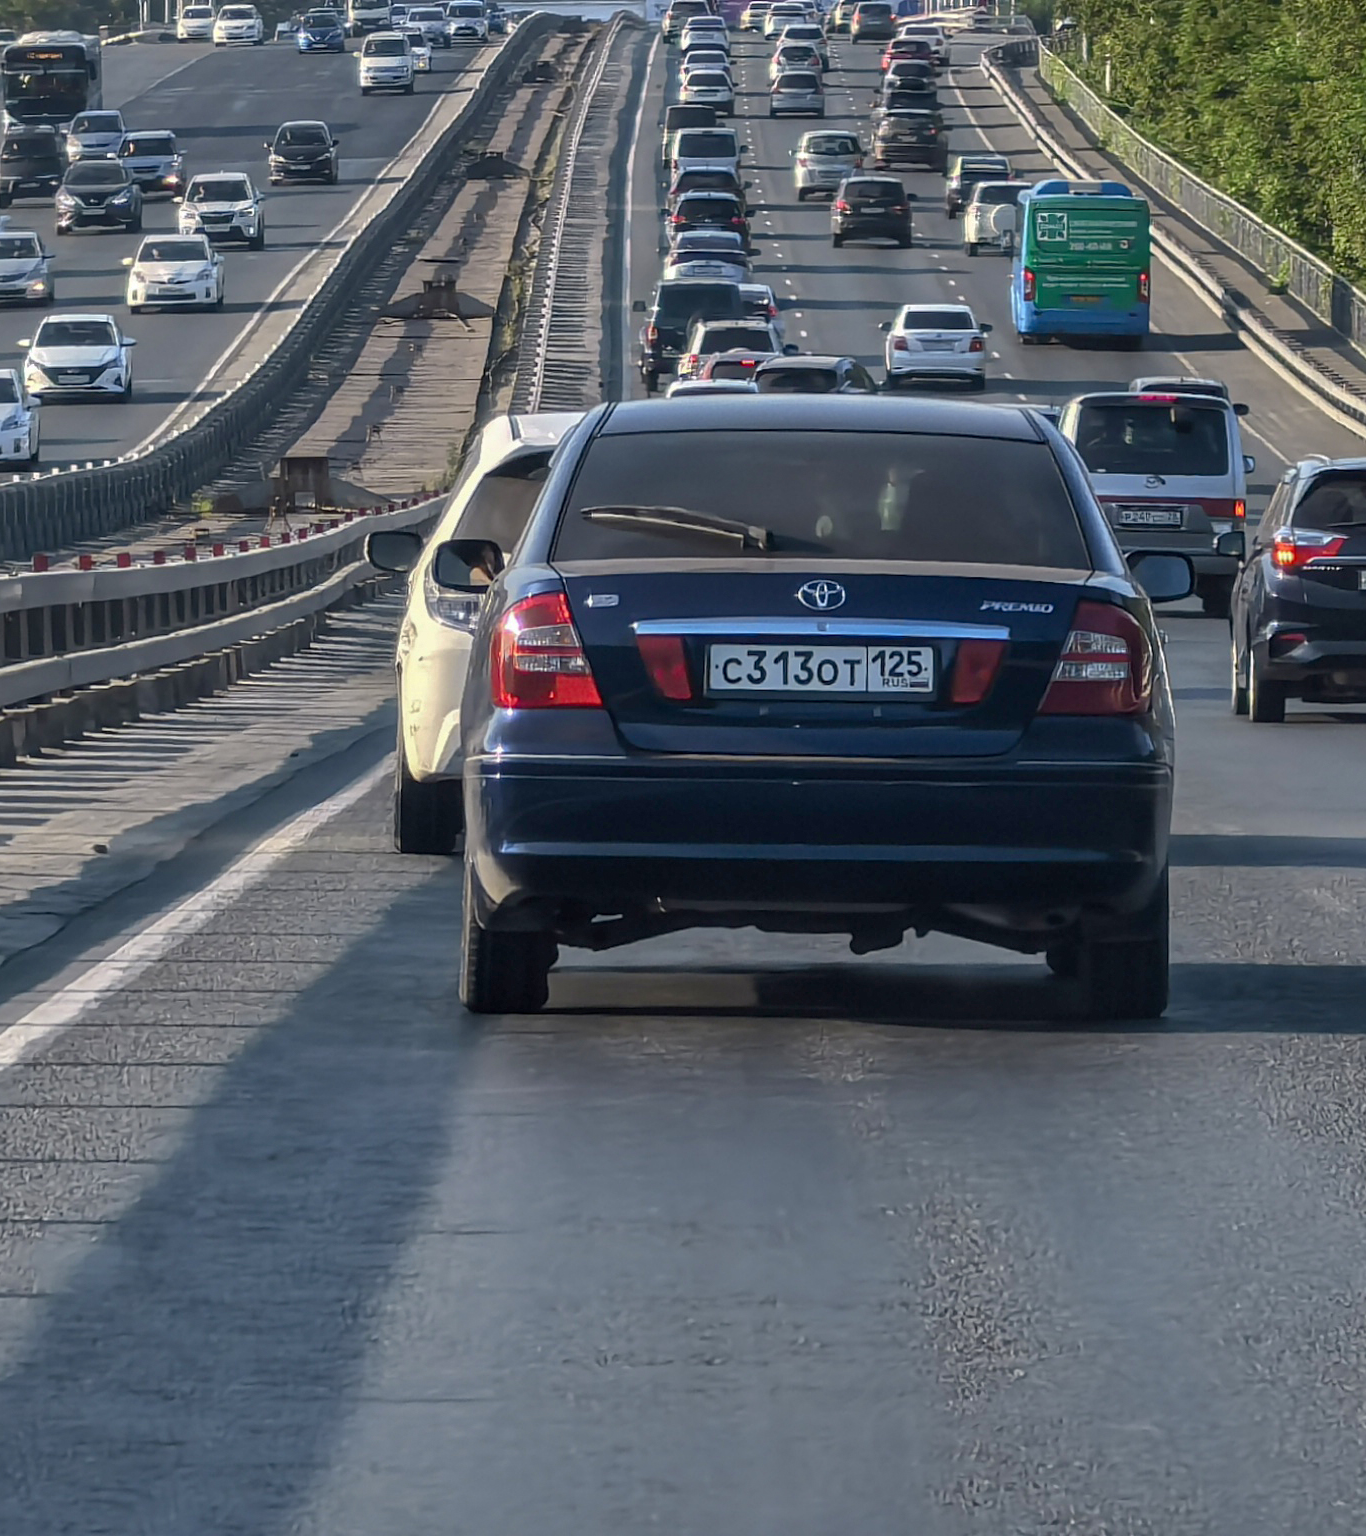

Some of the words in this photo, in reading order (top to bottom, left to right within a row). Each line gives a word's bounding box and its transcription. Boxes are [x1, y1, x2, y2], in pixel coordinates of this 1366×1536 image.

[980, 600, 1054, 613] PREMIO
[722, 650, 862, 685] С313ОТ
[871, 650, 923, 677] 125
[882, 677, 908, 687] RUS
